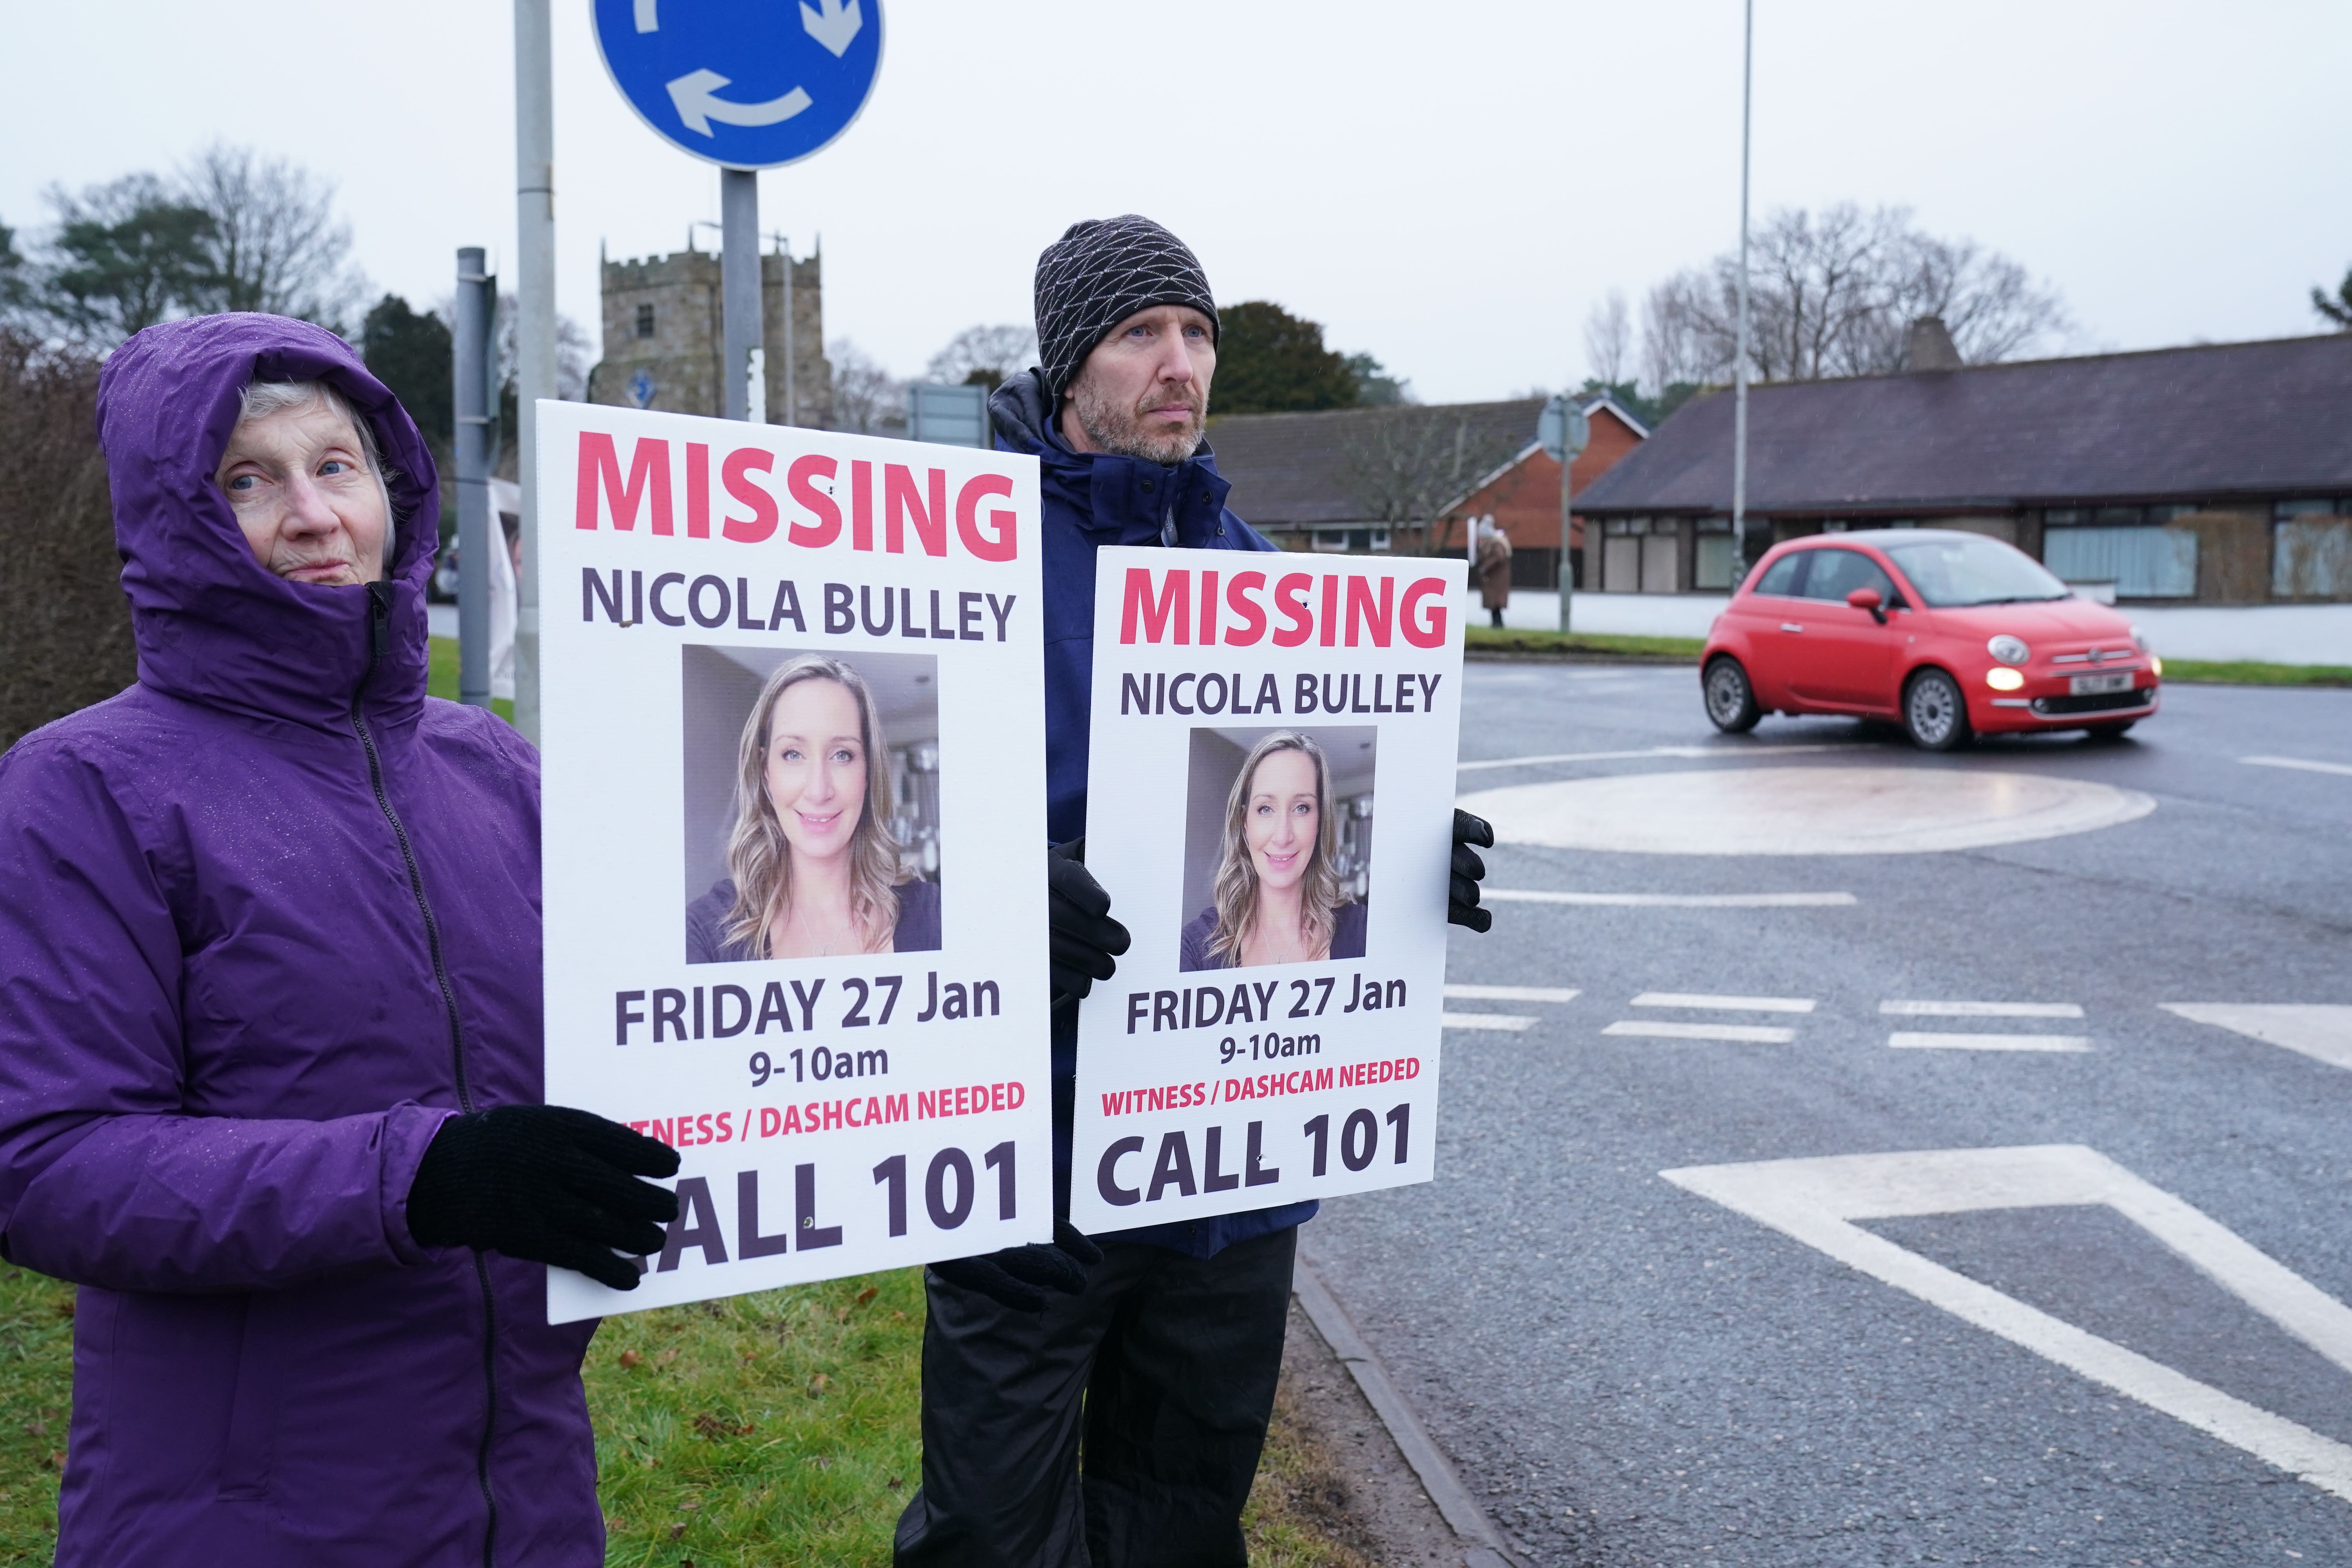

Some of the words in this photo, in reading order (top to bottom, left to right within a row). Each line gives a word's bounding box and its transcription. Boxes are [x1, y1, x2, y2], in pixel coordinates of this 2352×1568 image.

[576, 431, 1017, 562] MISSING
[583, 568, 806, 632] NICOLA
[824, 583, 1016, 642] BULLEY
[1120, 568, 1447, 648] MISSING
[1122, 673, 1281, 715] NICOLA
[1295, 673, 1442, 713] BULLEY
[616, 979, 825, 1045] FRIDAY
[842, 976, 902, 1027] 27
[917, 971, 999, 1022] Jan
[1127, 981, 1279, 1034] FRIDAY
[1289, 977, 1335, 1018] 27
[1344, 973, 1406, 1013] Jan
[750, 1047, 887, 1087] 9-10am
[1220, 1033, 1320, 1064] 9-10am
[741, 1109, 751, 1142] /
[761, 1094, 909, 1138] DASHCAM
[918, 1082, 1024, 1120] NEEDED
[1102, 1083, 1205, 1116] WITNESS
[1211, 1081, 1220, 1105] /
[1225, 1067, 1333, 1102] DASHCAM
[1339, 1058, 1419, 1087] NEEDED
[1097, 1121, 1279, 1205] CALL
[1304, 1103, 1410, 1177] 101
[627, 1163, 842, 1275] ALL
[873, 1141, 1016, 1237] 101
